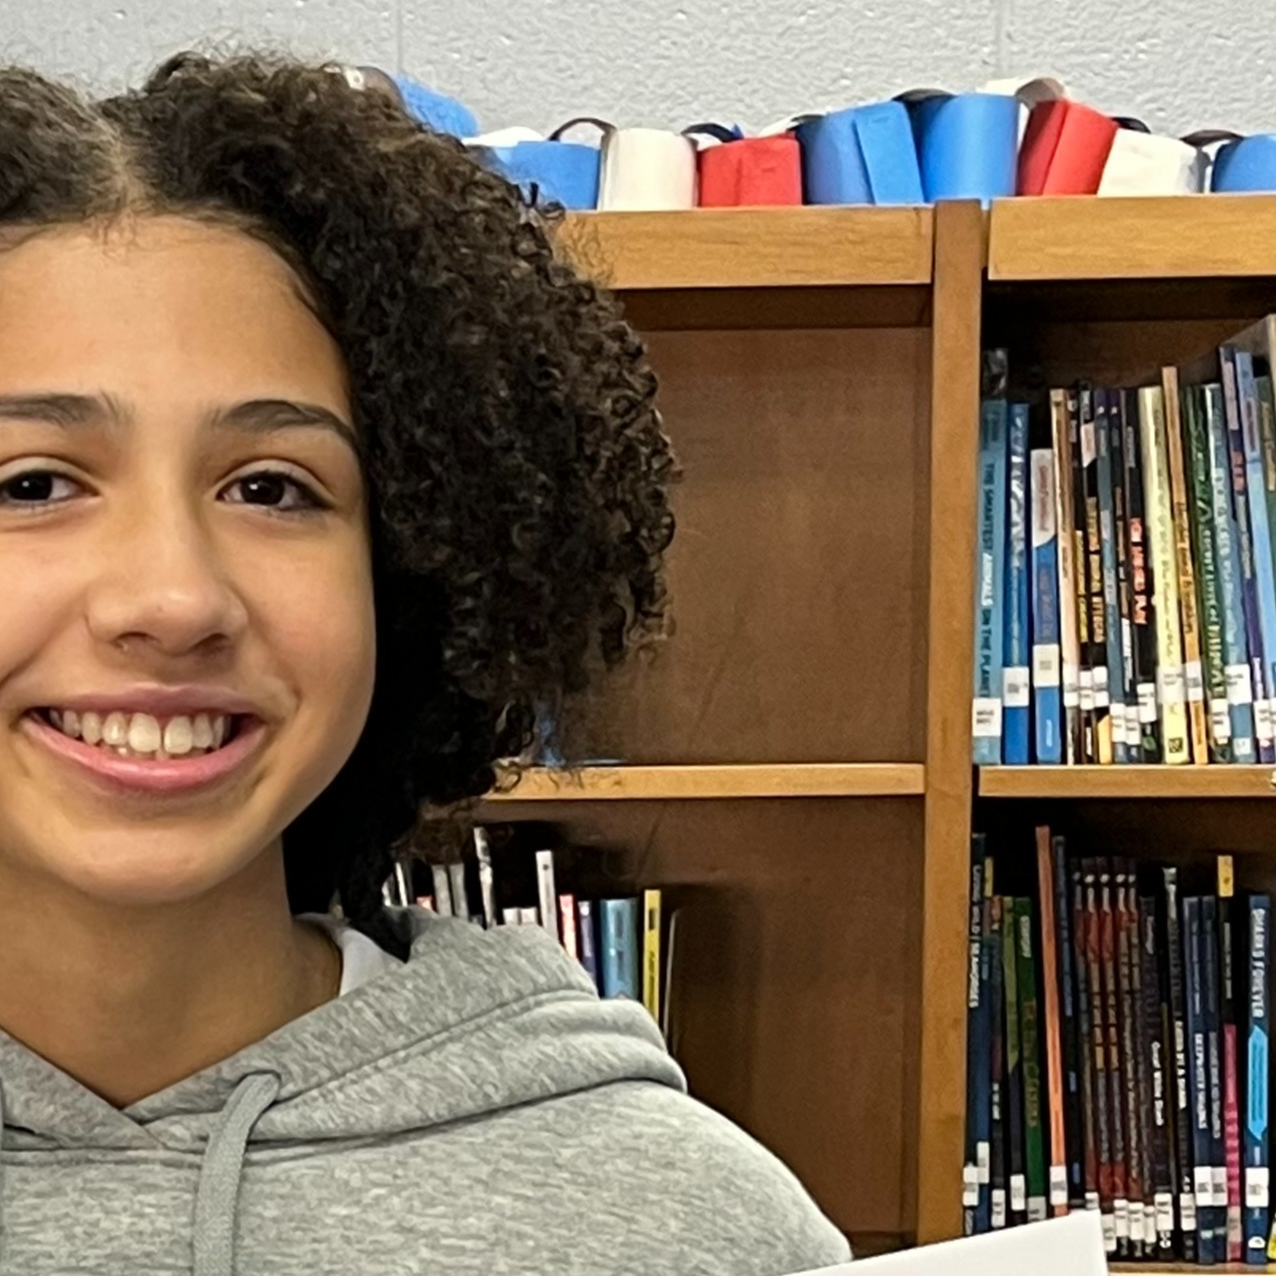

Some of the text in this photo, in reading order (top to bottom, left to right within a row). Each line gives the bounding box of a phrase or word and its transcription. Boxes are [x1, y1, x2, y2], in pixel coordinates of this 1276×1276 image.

[982, 463, 995, 485] THE
[983, 488, 995, 551] SMARTEST
[981, 552, 994, 606] ANIMALS
[981, 608, 993, 626] ON
[981, 629, 993, 653] THE
[1251, 908, 1266, 1018] SHARKS FOREVER
